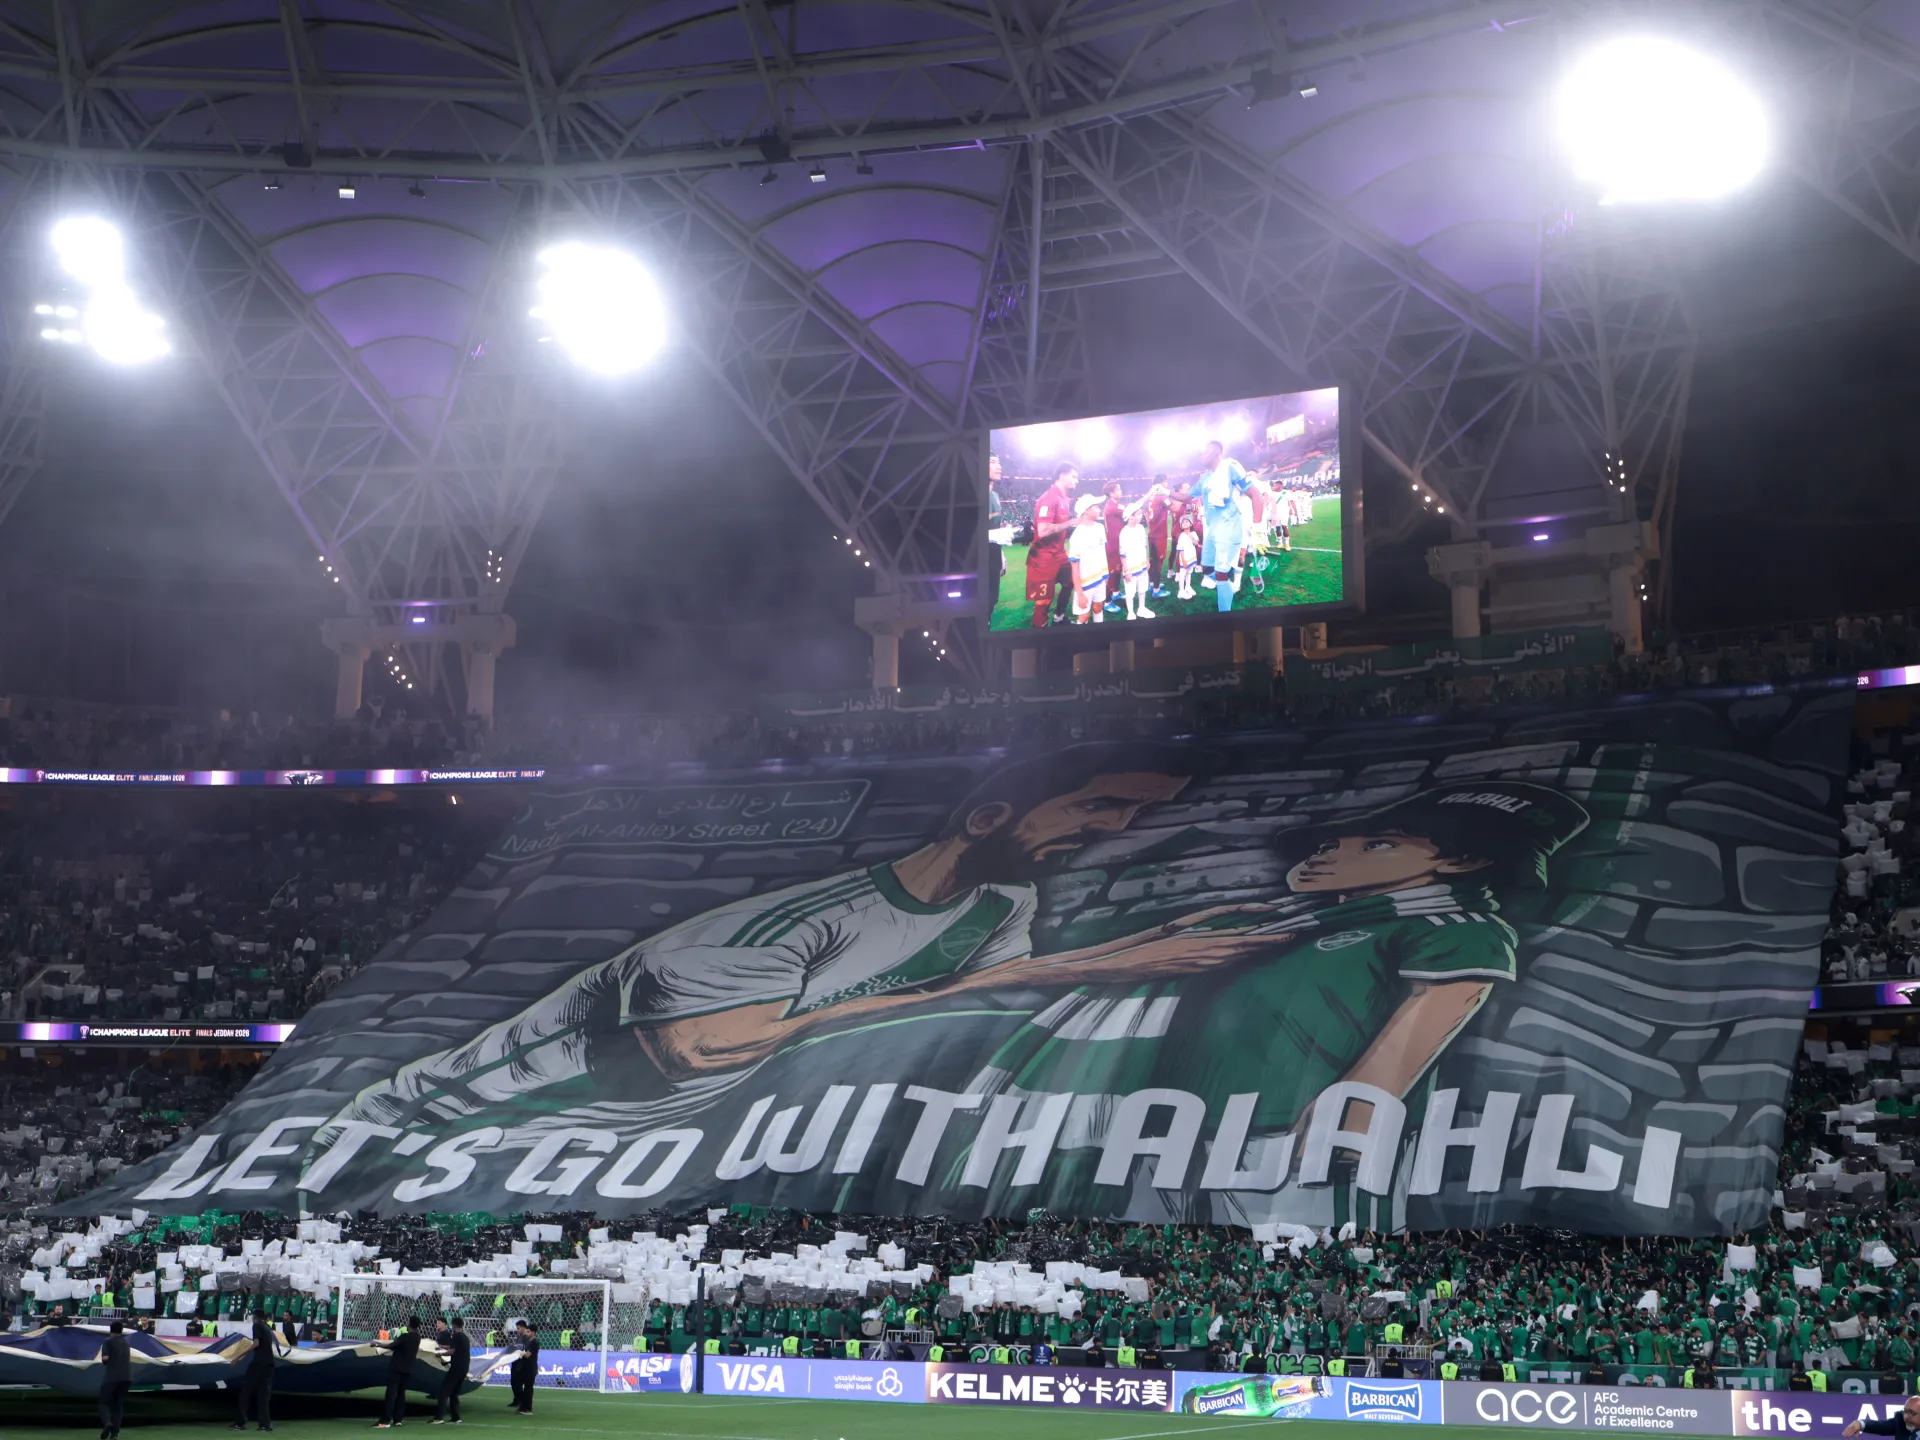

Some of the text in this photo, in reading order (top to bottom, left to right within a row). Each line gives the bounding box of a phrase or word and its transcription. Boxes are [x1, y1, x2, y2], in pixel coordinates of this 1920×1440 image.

[1039, 583, 1048, 597] 3
[48, 773, 89, 781] CHAMPIONS
[116, 774, 134, 782] ELITE
[432, 771, 471, 780] CHAMPIONS
[472, 771, 498, 779] LEAGUE
[499, 770, 517, 778] ELITE
[689, 822, 772, 840] Street
[781, 816, 838, 838] (24)
[92, 1029, 138, 1037] CHAMPIONS
[138, 1029, 168, 1037] LEAGUE
[169, 1029, 191, 1037] ELITE
[133, 1081, 1682, 1209] LET'S GO WITH ALAHLI
[1530, 1340, 1538, 1353] 7
[715, 1362, 786, 1394] VISA
[855, 1382, 872, 1390] bank
[929, 1372, 1168, 1407] KELME 卡尔美
[1199, 1393, 1244, 1414] BARBICAN
[1351, 1391, 1416, 1408] BARBICAN
[1593, 1392, 1619, 1404] AFC
[1475, 1387, 1578, 1424] ace
[1594, 1404, 1698, 1418] Academic Centre
[1377, 1413, 1404, 1421] BEVERAGE
[1594, 1415, 1674, 1429] of Excellence
[1741, 1399, 1812, 1432] the
